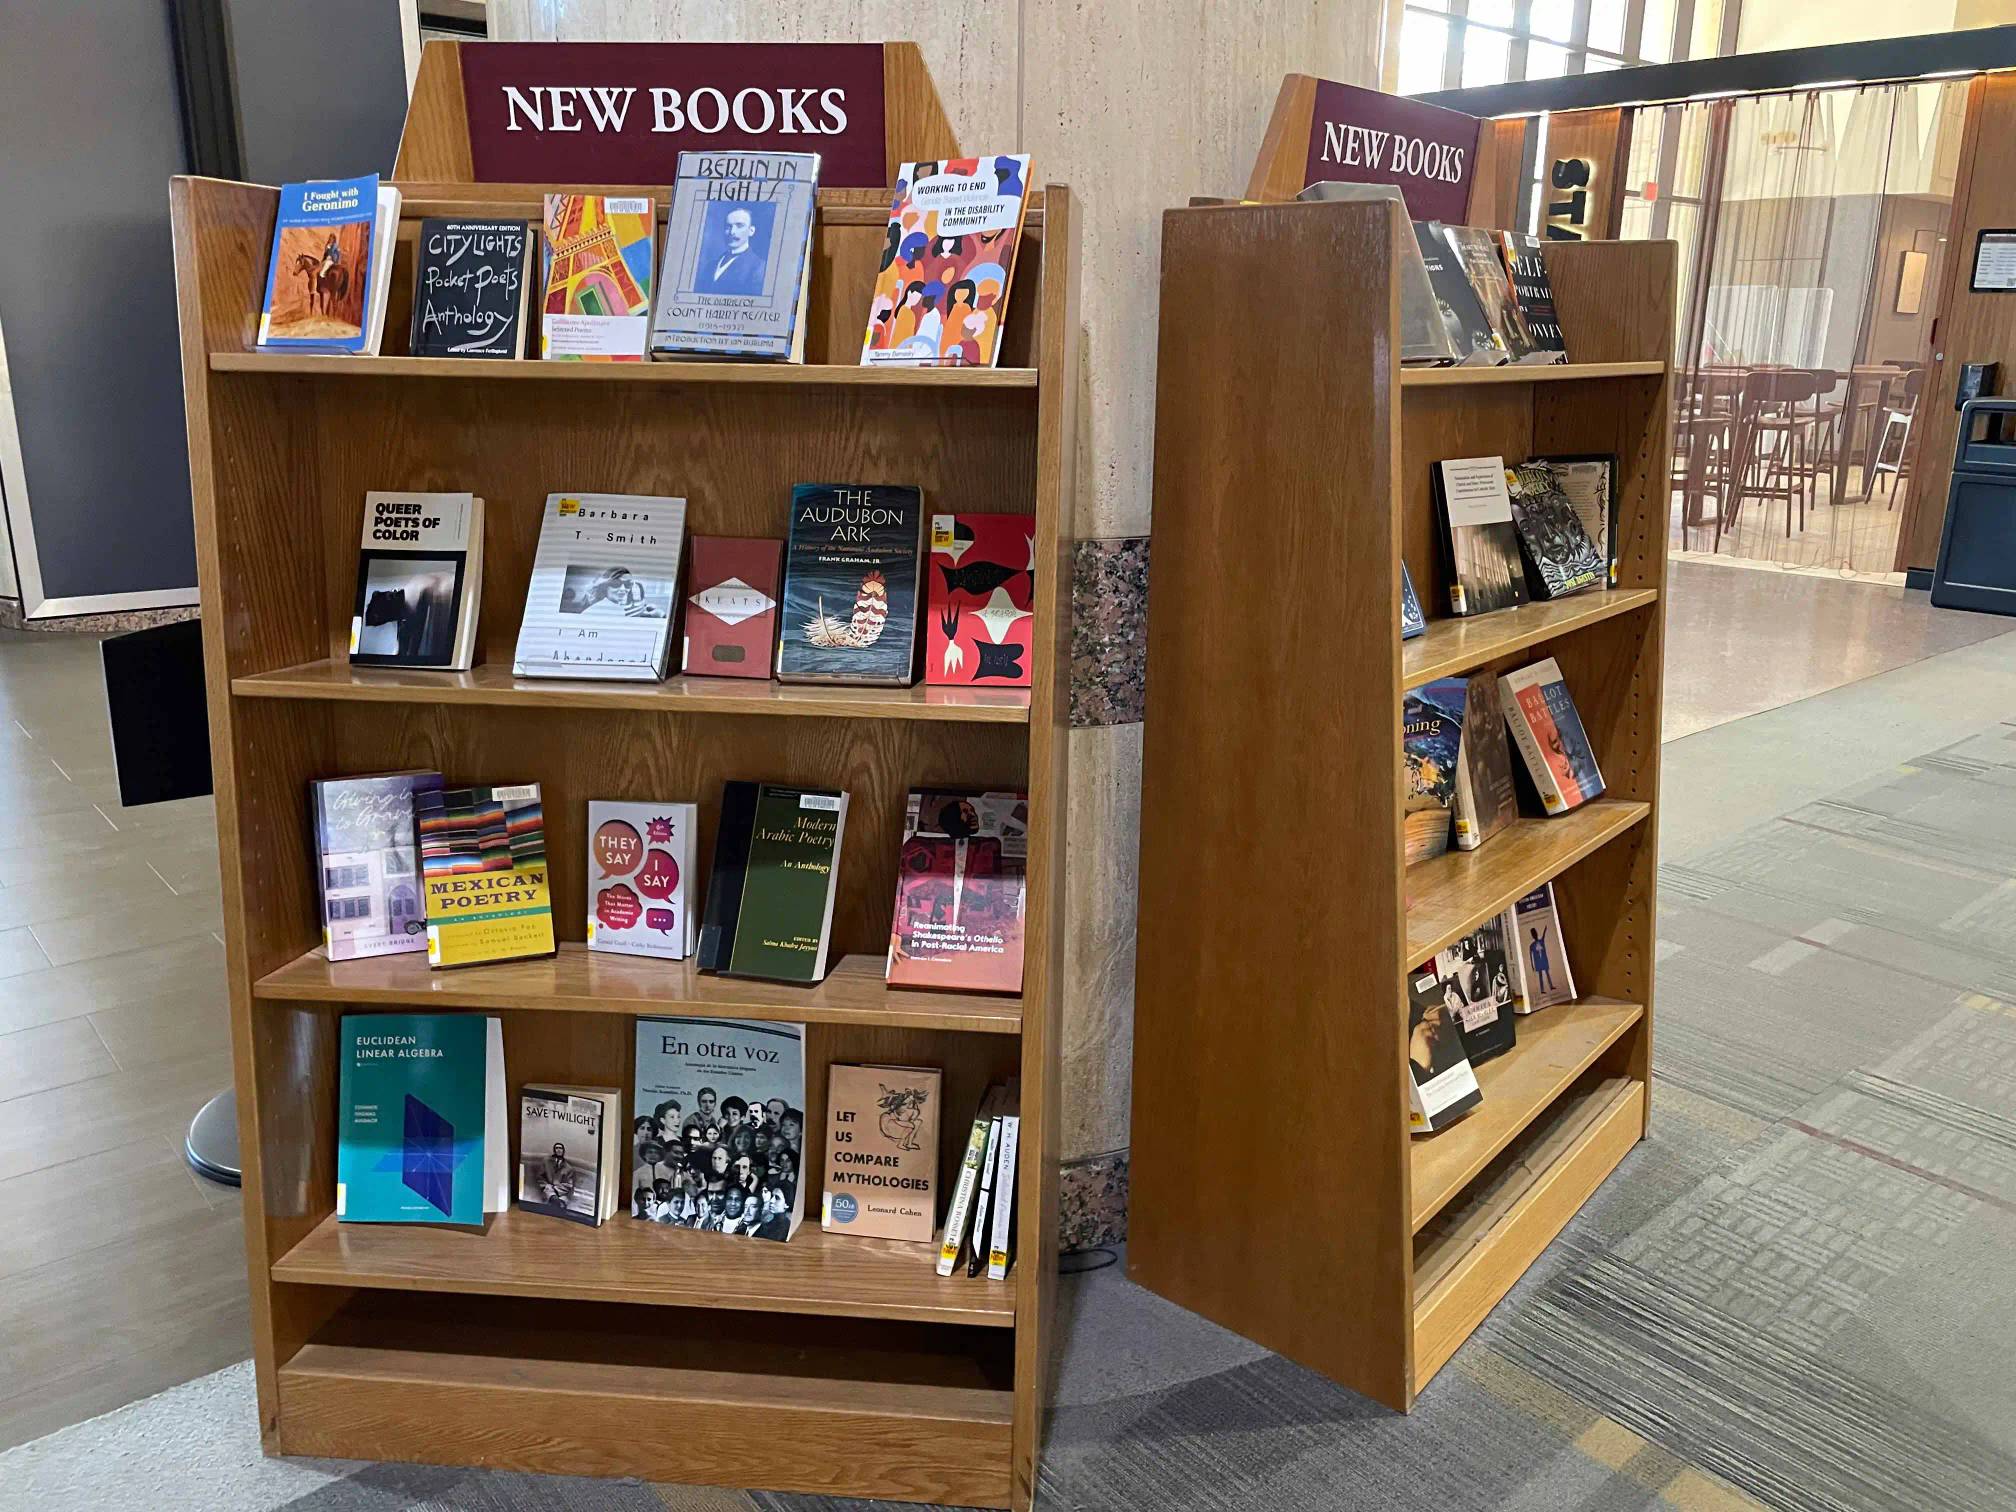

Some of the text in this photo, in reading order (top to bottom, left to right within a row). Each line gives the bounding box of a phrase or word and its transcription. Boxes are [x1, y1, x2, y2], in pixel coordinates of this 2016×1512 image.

[501, 86, 848, 135] NEW BOOKS
[1320, 121, 1465, 184] NEW BOOKS
[698, 157, 798, 182] BERLIN IN
[310, 189, 340, 202] Fought
[341, 187, 359, 198] with
[706, 179, 780, 201] LIGHTS
[917, 181, 986, 195] WORKING TO END
[302, 198, 359, 212] Geronimo
[944, 204, 1005, 217] IN THE DISABILITY
[461, 224, 498, 232] ANNIVERSARY
[942, 215, 988, 227] COMMUNITY
[425, 262, 518, 306] Pocket Poets
[666, 307, 704, 318] COUNT
[422, 299, 514, 350] Anthology
[833, 489, 873, 507] THE
[375, 502, 422, 515] QUEER
[578, 508, 650, 521] Barbara
[373, 517, 441, 528] POETS OF
[799, 507, 904, 526] AUDUBON
[372, 529, 420, 541] COLOR
[575, 530, 657, 545] T. Smith
[830, 526, 871, 542] ARK
[578, 629, 598, 639] Am
[793, 816, 837, 832] Modern
[599, 836, 638, 850] THEY
[756, 827, 836, 850] Arabic Poetry
[605, 852, 632, 865] SAY
[654, 859, 659, 871] I
[780, 859, 831, 875] An Anthology
[430, 872, 544, 895] MEXICAN
[643, 874, 670, 888] SAY
[440, 889, 537, 909] POETRY
[609, 915, 628, 924] Writing
[913, 921, 966, 933] Reanimating
[912, 930, 1004, 944] Shakespeare's Othello
[920, 940, 968, 951] Post-Racial
[968, 943, 1004, 954] America
[356, 1036, 416, 1046] EUCLIDEAN
[356, 1049, 444, 1059] LINEAR ALGEBRA
[661, 1035, 780, 1064] En otra voz
[526, 1106, 596, 1127] SAVE TWILIGHT
[836, 1111, 856, 1122] LET
[835, 1131, 853, 1142] US
[834, 1151, 900, 1167] COMPARE
[1003, 1143, 1011, 1170] AUDEN
[833, 1172, 929, 1191] MYTHOLOGIES
[867, 1205, 923, 1217] Leonard Cohen
